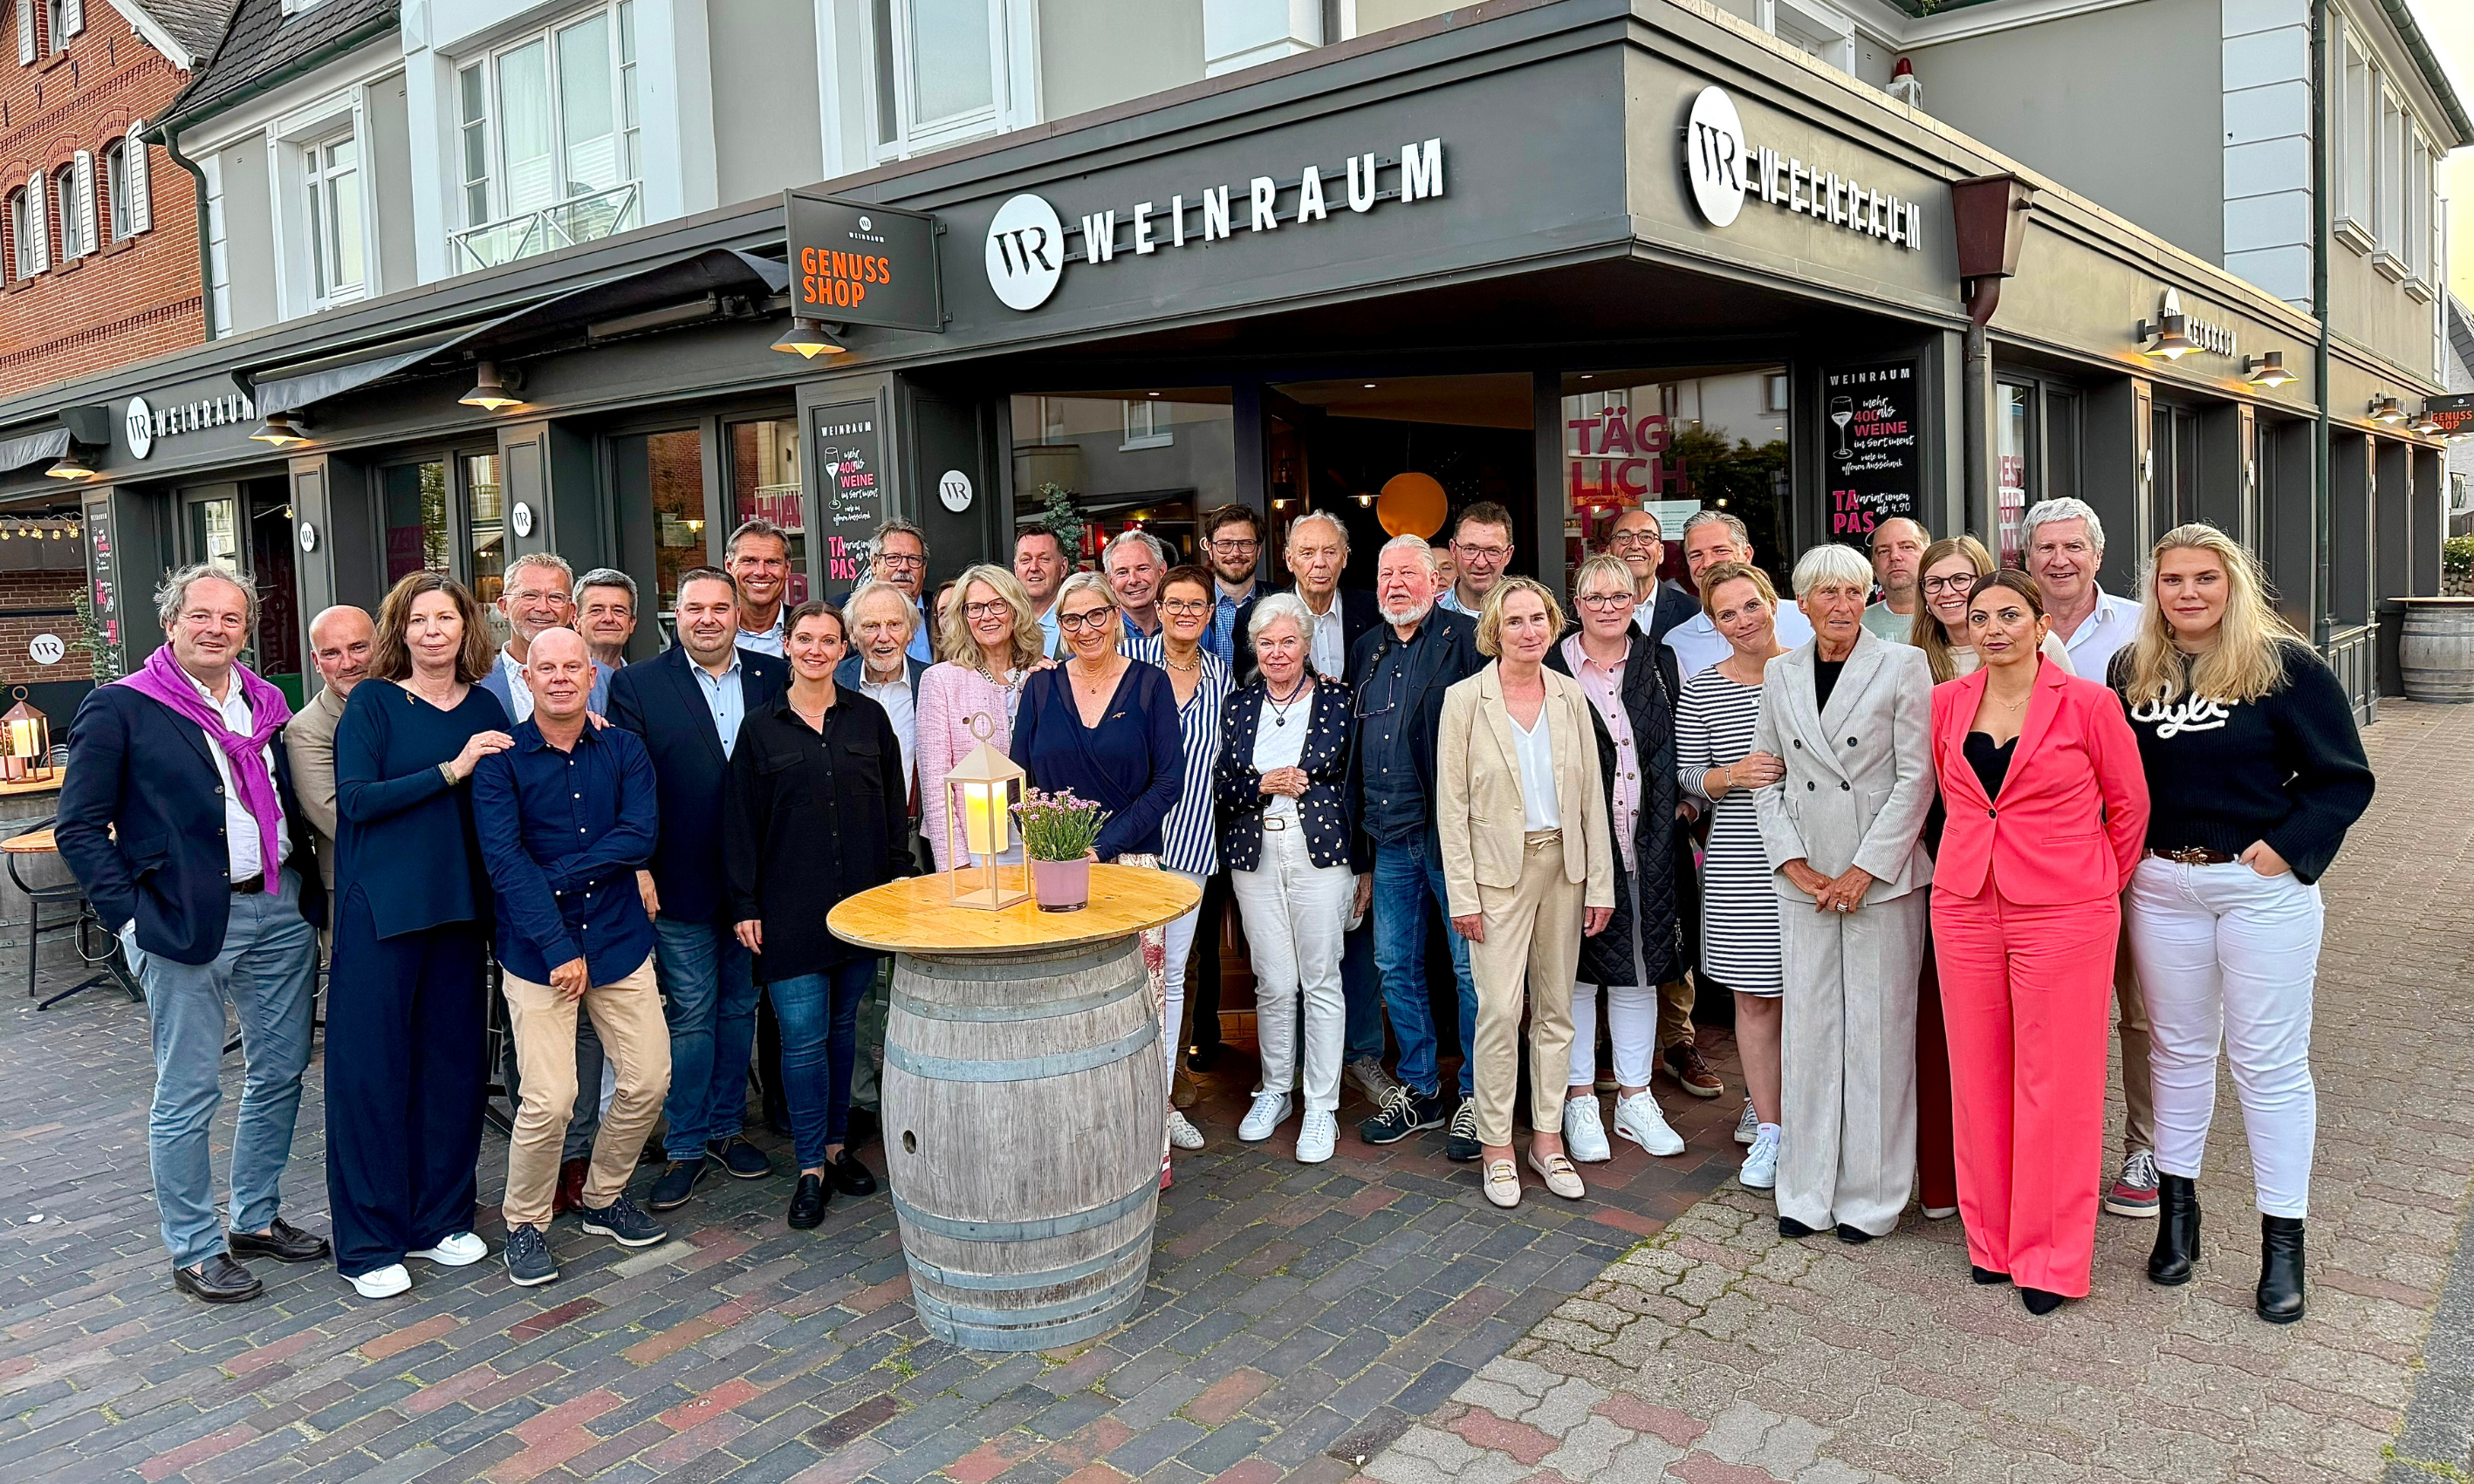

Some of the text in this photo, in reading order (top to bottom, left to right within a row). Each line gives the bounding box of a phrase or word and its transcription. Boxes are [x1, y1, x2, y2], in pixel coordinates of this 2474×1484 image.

[993, 137, 1443, 278] WR WEINRAUM
[1758, 145, 1921, 251] WEINRAUM
[801, 247, 890, 284] GENUSS
[802, 275, 866, 308] SHOP
[1830, 368, 1909, 386] WEINRAUM
[1863, 395, 1888, 408] mehr
[1877, 405, 1896, 418] als
[155, 393, 255, 437] WEINRAUM
[2431, 410, 2473, 422] GENUSS
[2437, 421, 2460, 430] HOP
[821, 421, 872, 437] WEINRAUM
[1568, 406, 1670, 455] TÄG
[1854, 421, 1908, 436] WEINE
[840, 473, 874, 489] WEINE
[1572, 456, 1688, 497] LICH
[942, 482, 970, 500] WR
[1833, 489, 1860, 511] TA
[1833, 510, 1875, 534] PAS
[828, 536, 846, 557] TA
[830, 557, 856, 580] PAS
